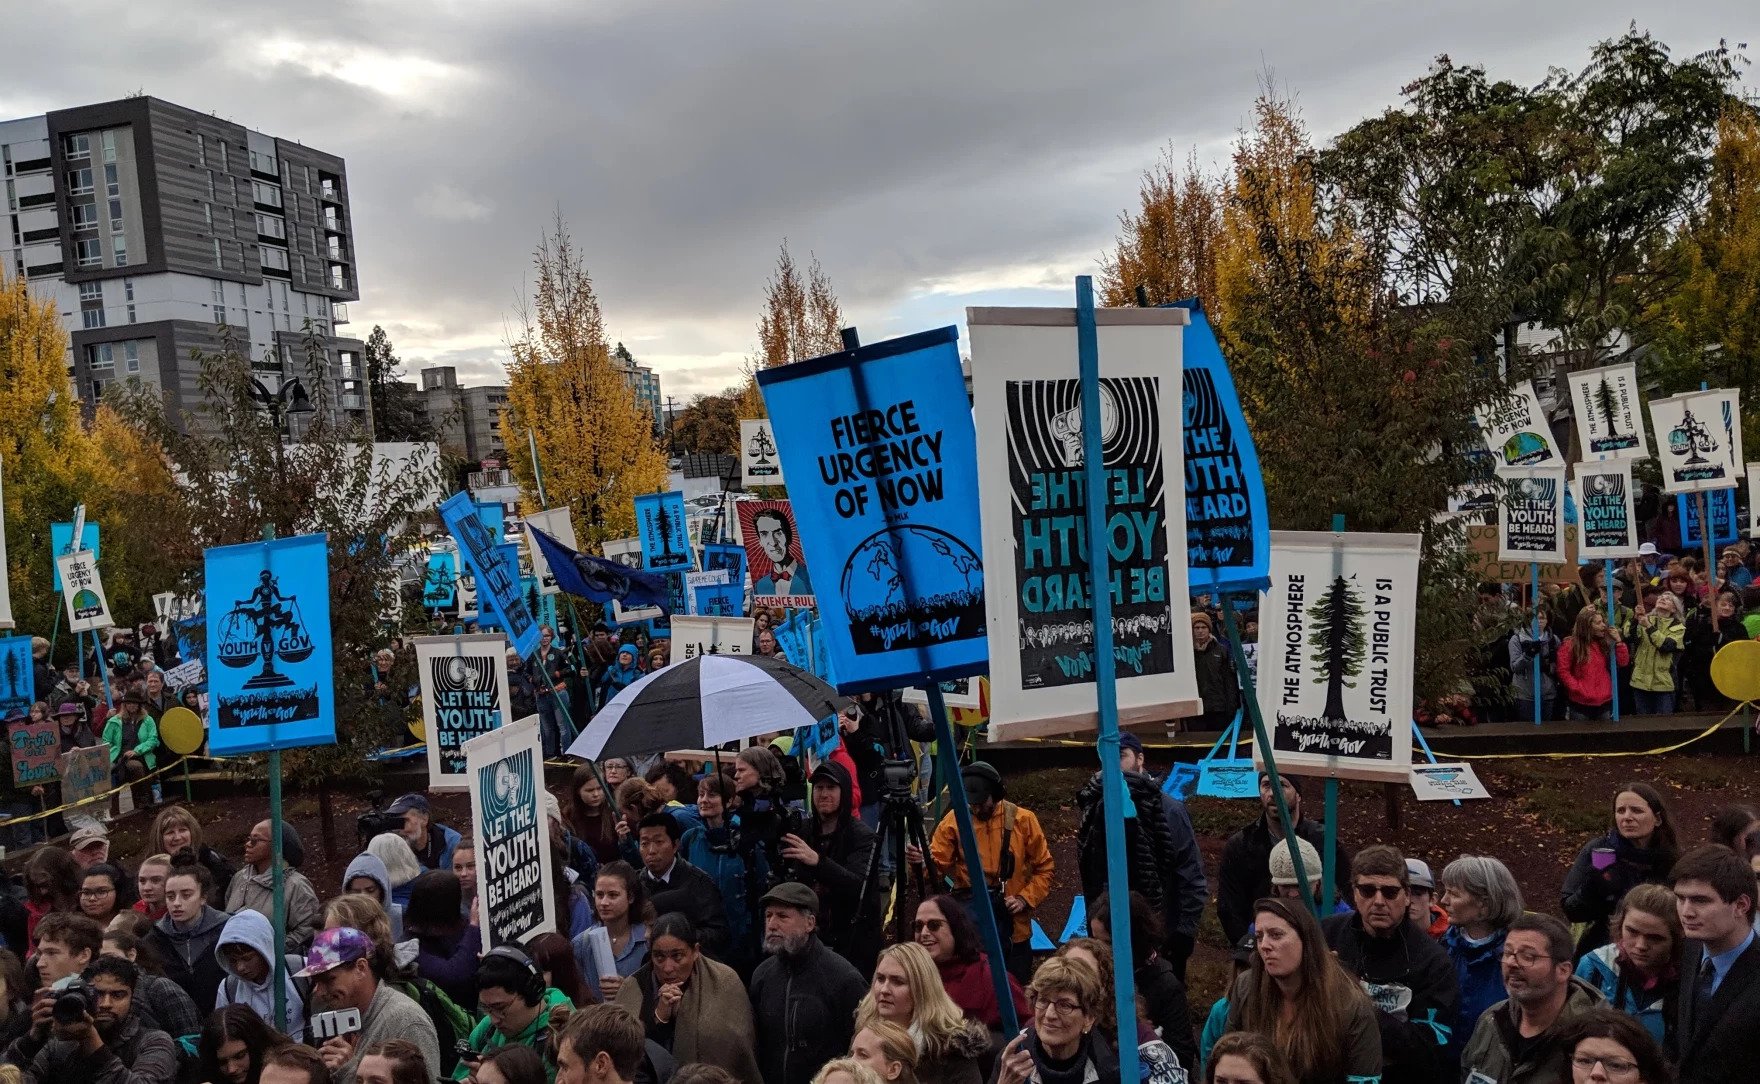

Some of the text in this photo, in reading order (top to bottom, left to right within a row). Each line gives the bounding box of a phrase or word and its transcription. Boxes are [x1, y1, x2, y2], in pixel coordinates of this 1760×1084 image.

[830, 400, 920, 449] FIERCE
[1498, 416, 1532, 434] OF NOW
[818, 430, 943, 487] URGENCY
[834, 468, 944, 519] OF NOW
[1532, 500, 1551, 510] THE
[1588, 496, 1621, 506] LET THE
[1510, 510, 1554, 524] YOUTH
[1585, 506, 1625, 520] YOUTH
[1509, 524, 1521, 533] BE
[1522, 524, 1555, 534] HEARD
[1586, 520, 1627, 530] BE HEARD
[70, 562, 87, 571] FIERCE
[67, 569, 91, 581] URGENCY
[71, 577, 92, 588] OF NOW
[709, 597, 729, 606] FIERCE
[756, 597, 792, 606] SCIENCE
[218, 641, 258, 655] YOUTH
[279, 635, 310, 650] GOV
[1283, 574, 1305, 706] THE ATMOSPHERE
[1370, 578, 1393, 715] IS A PUBLIC TRUST
[732, 645, 740, 653] IS
[441, 690, 491, 707] LET THE
[438, 709, 494, 729] YOUTH
[440, 732, 456, 746] BE
[489, 802, 531, 843] LET THE
[486, 827, 537, 880] YOUTH
[488, 860, 540, 909] BE HEARD
